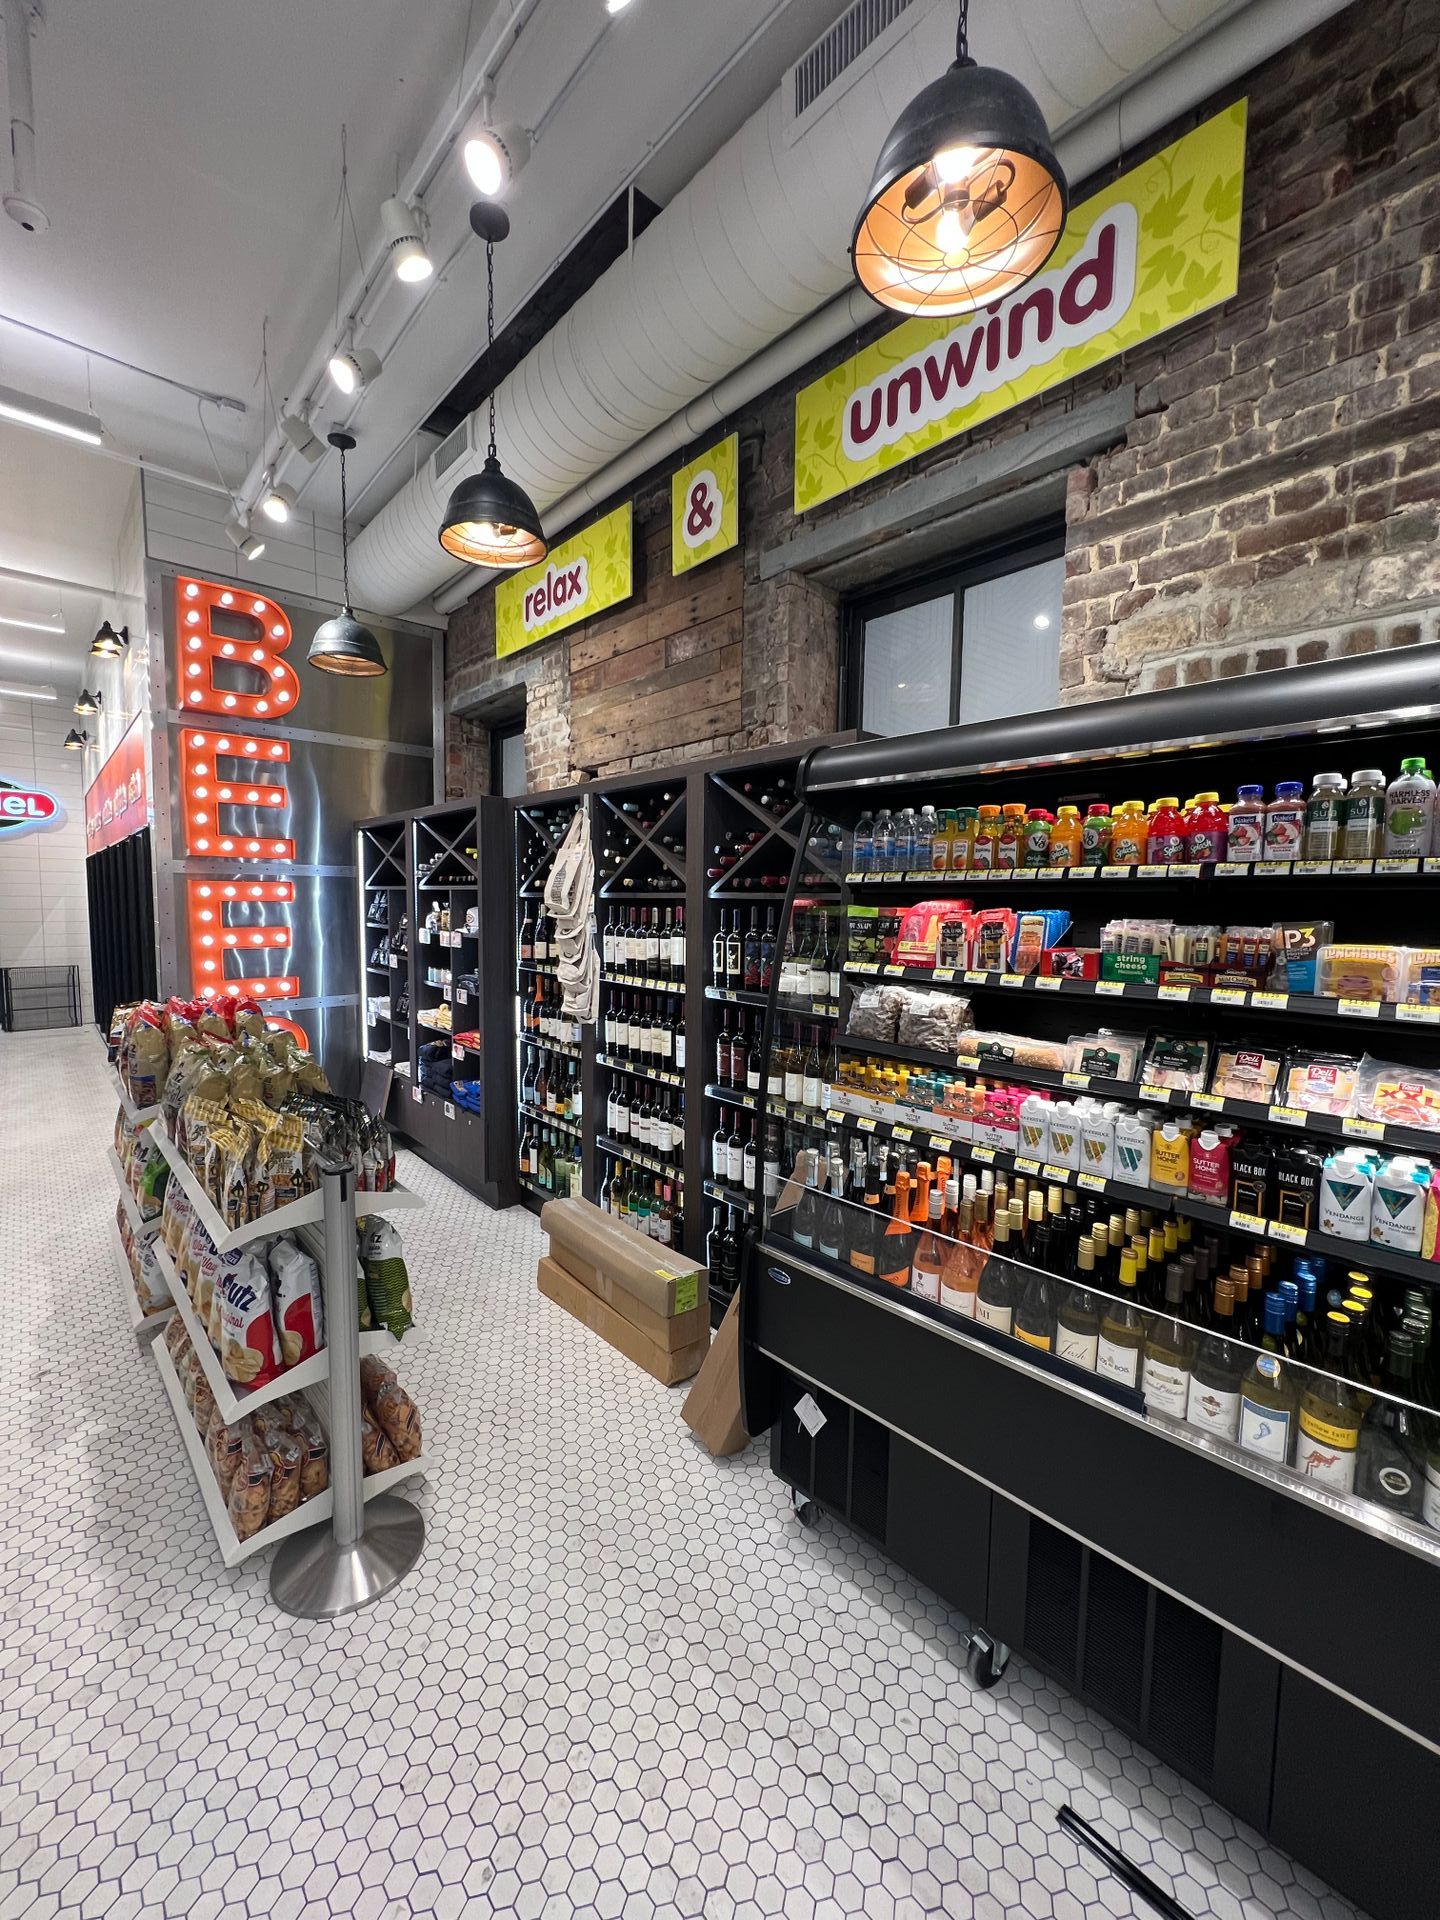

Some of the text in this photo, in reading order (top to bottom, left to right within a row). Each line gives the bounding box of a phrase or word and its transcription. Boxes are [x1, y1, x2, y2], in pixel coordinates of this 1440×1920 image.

[850, 223, 1116, 444] unwind
[686, 481, 715, 537] &
[524, 565, 583, 623] relax
[176, 574, 311, 1052] BEE
[1284, 927, 1316, 948] P3
[1114, 963, 1147, 971] cheese
[1116, 955, 1146, 964] string
[1155, 1149, 1180, 1160] SUTTER
[1156, 1155, 1177, 1165] HOME
[1193, 1157, 1220, 1168] SUTTER
[1195, 1164, 1218, 1174] HOME
[1233, 1162, 1267, 1177] BLACK BOX
[1278, 1171, 1314, 1187] BLACK BOX
[1324, 1208, 1365, 1221] VENDANGE
[1374, 1215, 1417, 1231] VENDANGE
